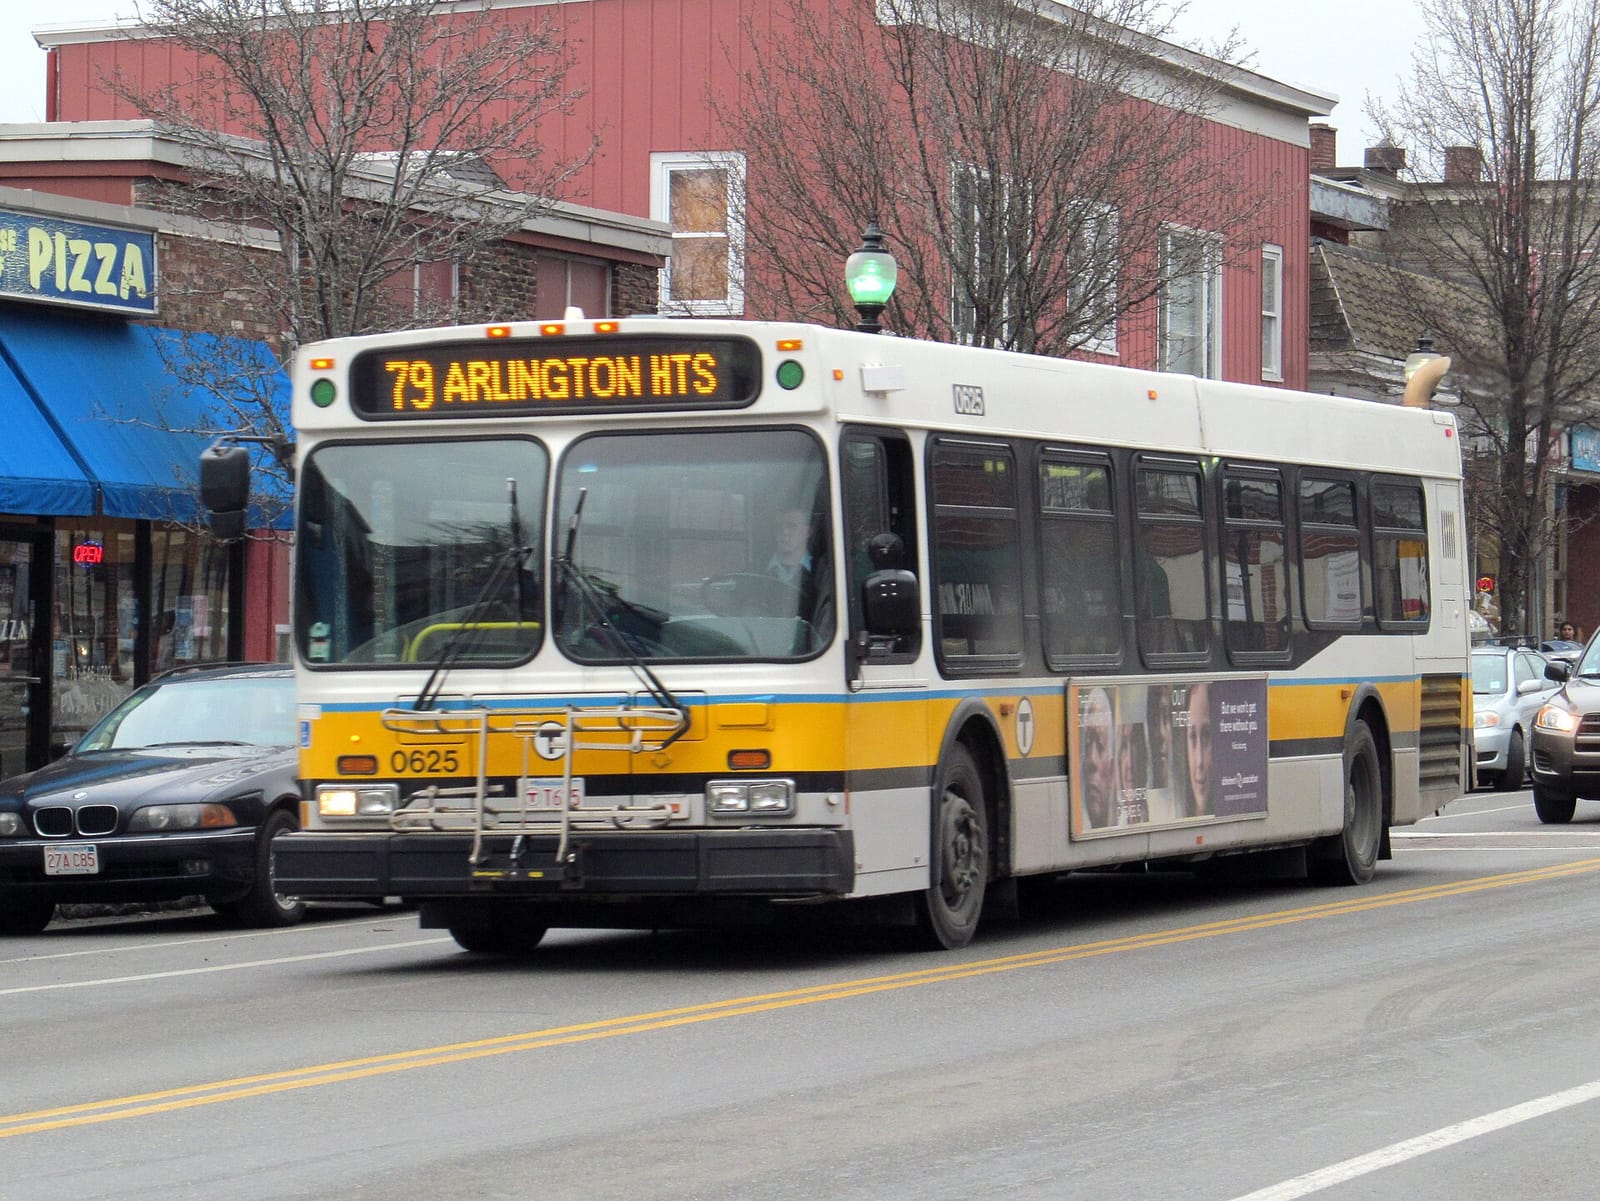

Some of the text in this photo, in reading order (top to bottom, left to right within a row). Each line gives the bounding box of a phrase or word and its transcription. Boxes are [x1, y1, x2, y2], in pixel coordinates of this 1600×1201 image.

[28, 227, 147, 300] PIZZA
[385, 354, 718, 409] 79 ARLINGTON HTS
[74, 545, 103, 563] OPEN
[391, 750, 459, 773] 0625
[543, 787, 580, 806] T65
